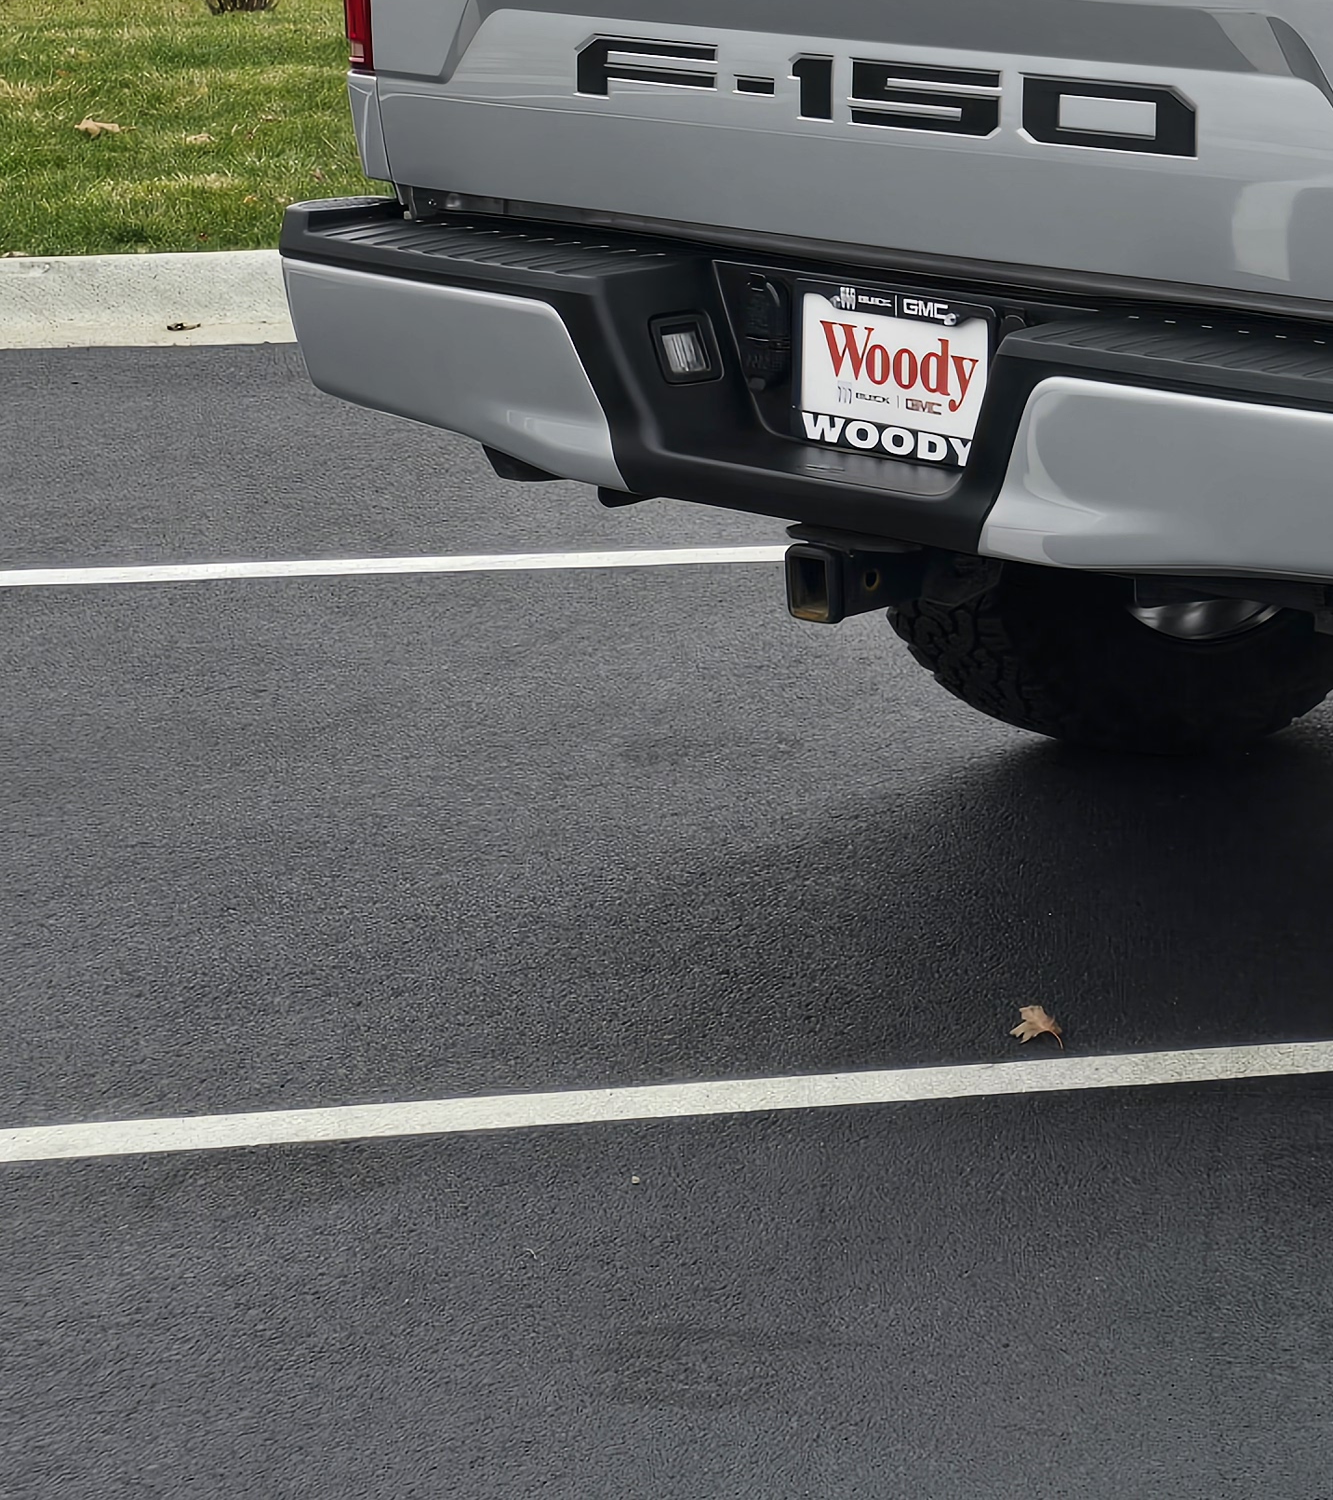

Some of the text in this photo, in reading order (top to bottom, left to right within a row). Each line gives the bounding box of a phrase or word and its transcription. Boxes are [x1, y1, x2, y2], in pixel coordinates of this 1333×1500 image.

[574, 34, 1198, 160] F-150
[902, 298, 949, 319] GMC
[820, 320, 979, 412] Woody
[905, 398, 942, 415] GMC
[801, 411, 973, 467] WOODY
